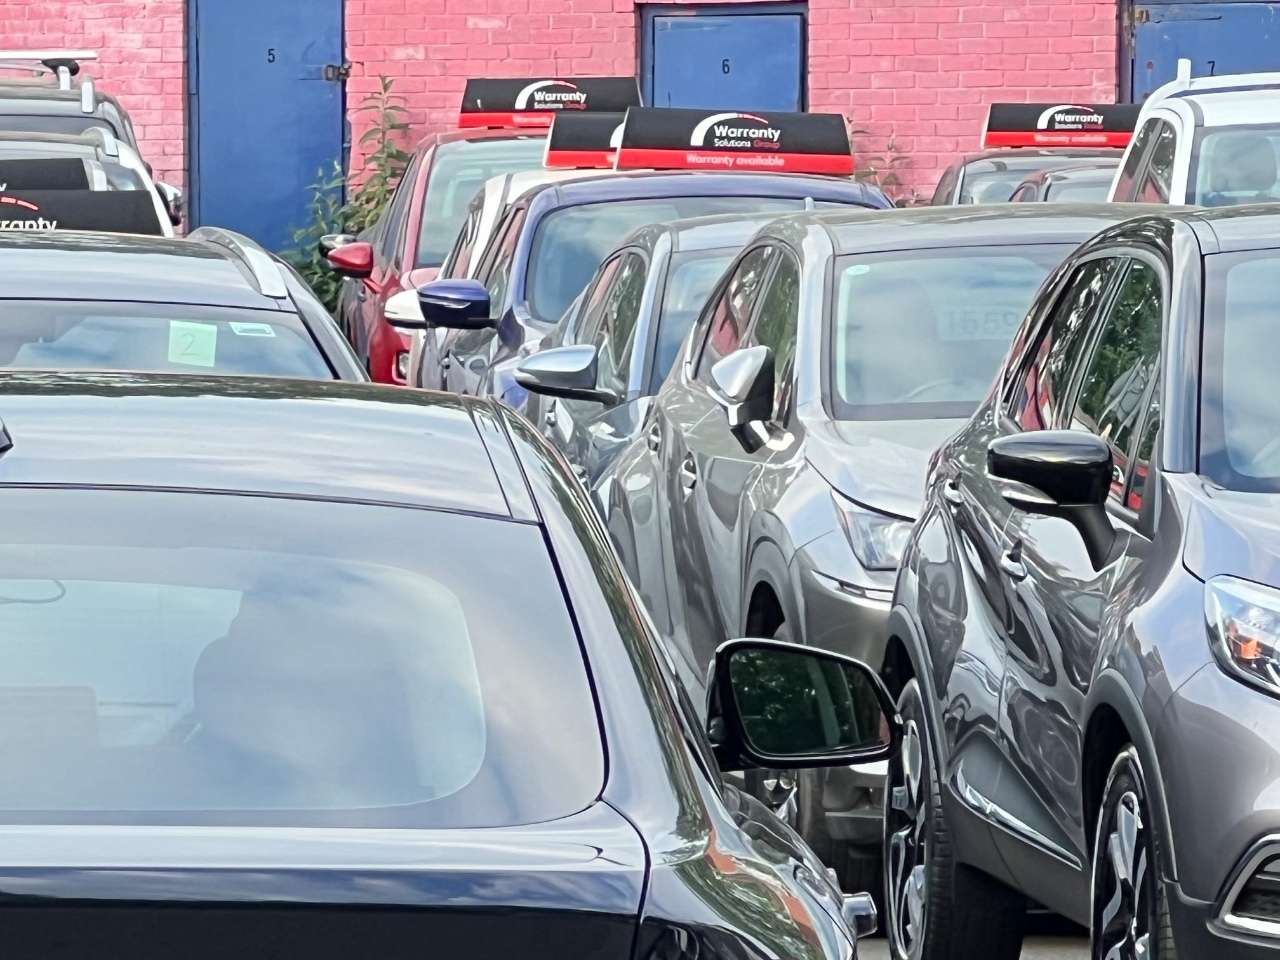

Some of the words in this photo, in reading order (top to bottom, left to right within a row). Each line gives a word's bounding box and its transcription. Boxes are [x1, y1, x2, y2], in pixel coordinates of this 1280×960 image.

[267, 48, 276, 63] 5
[722, 58, 730, 74] 6
[1207, 60, 1216, 76] 7
[534, 91, 587, 104] Warranty
[1054, 113, 1104, 124] Warranty
[713, 125, 781, 142] Warranty
[713, 139, 751, 147] Solutions
[686, 153, 735, 167] Warranty
